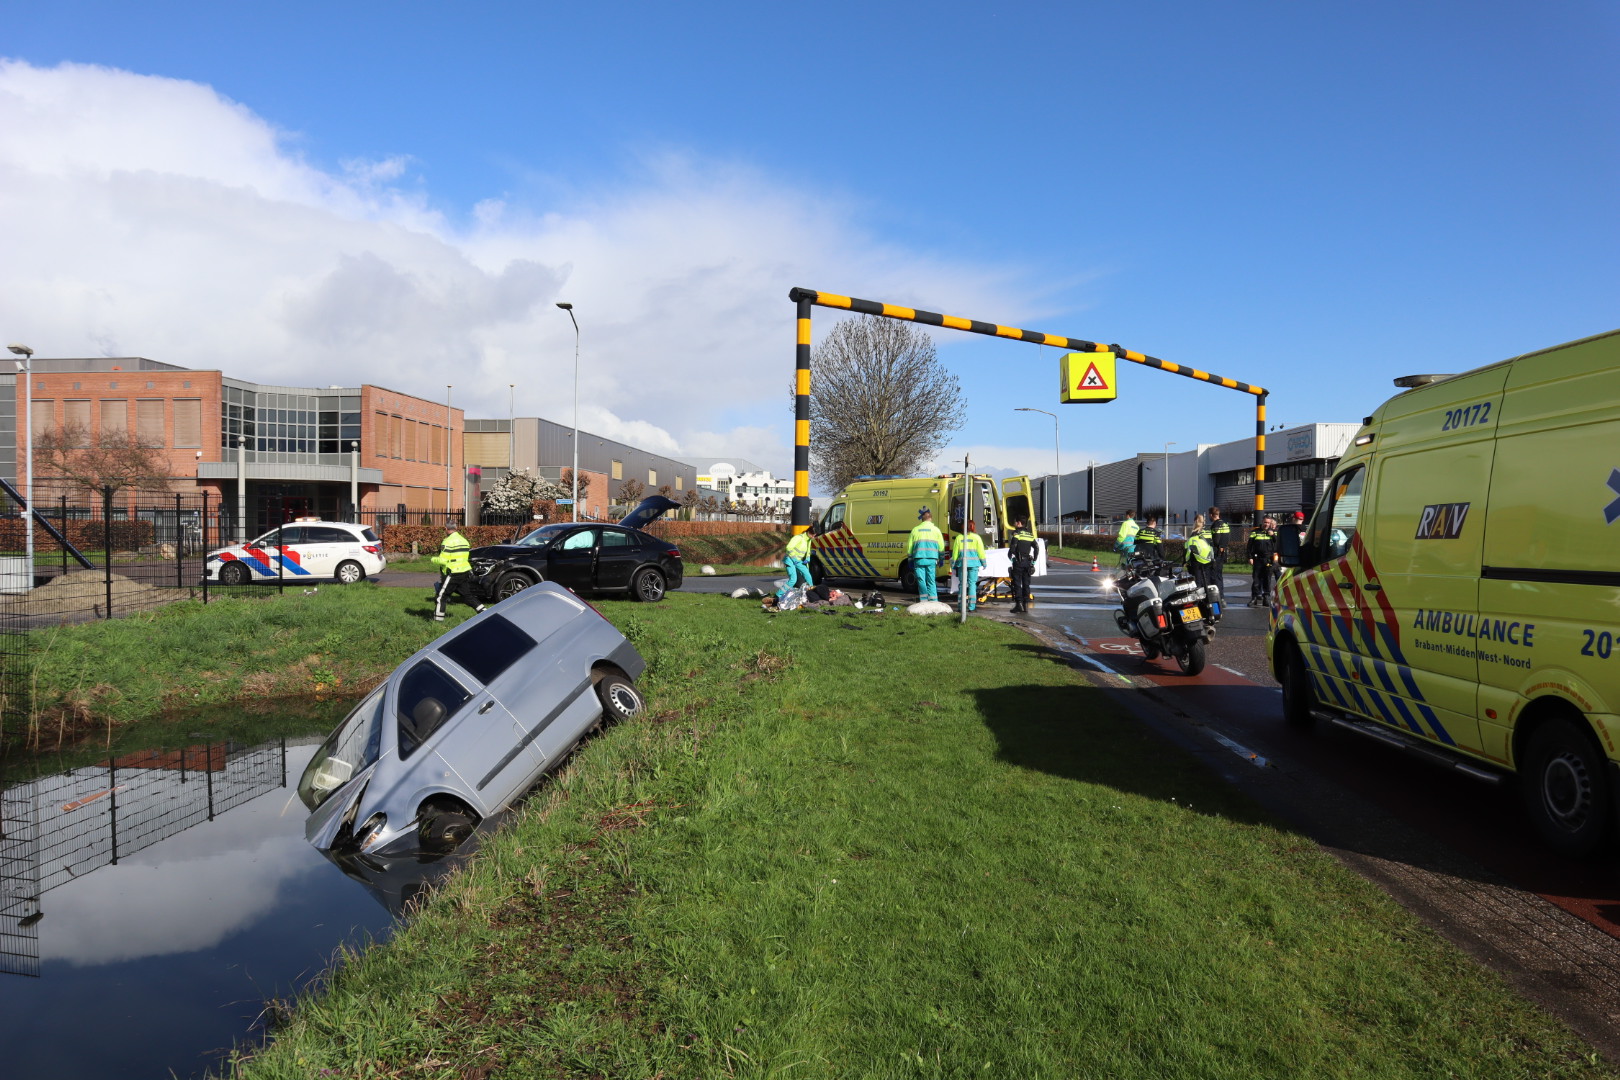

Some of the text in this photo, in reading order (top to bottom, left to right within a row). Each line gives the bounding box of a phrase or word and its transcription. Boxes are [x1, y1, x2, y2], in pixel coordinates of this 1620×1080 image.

[1442, 402, 1491, 431] 20172
[1417, 505, 1468, 537] RAV
[1413, 608, 1535, 647] AMBULANCE
